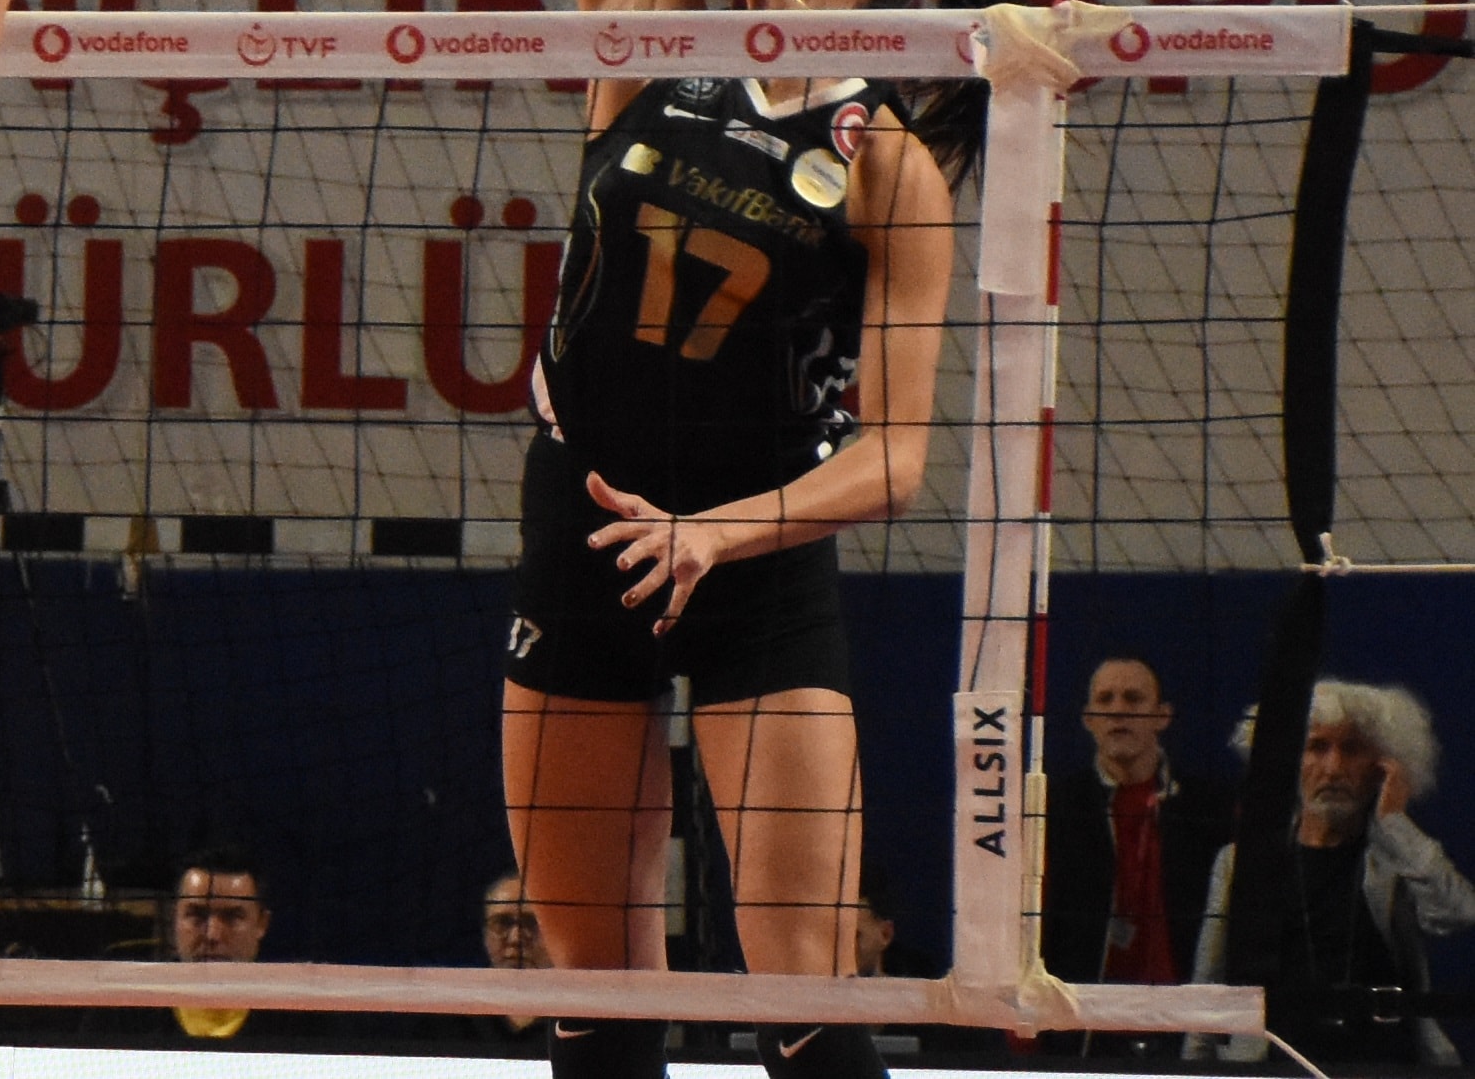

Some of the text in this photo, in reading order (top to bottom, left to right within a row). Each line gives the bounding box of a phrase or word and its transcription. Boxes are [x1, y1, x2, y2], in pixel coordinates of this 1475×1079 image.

[77, 30, 189, 53] vodafone
[281, 36, 338, 58] TVF
[431, 31, 545, 54] vodafone
[639, 35, 696, 58] TVF
[791, 29, 906, 52] vodafone
[1157, 28, 1274, 52] vodafone
[634, 202, 771, 362] 17
[972, 705, 1007, 858] ALLSIX
